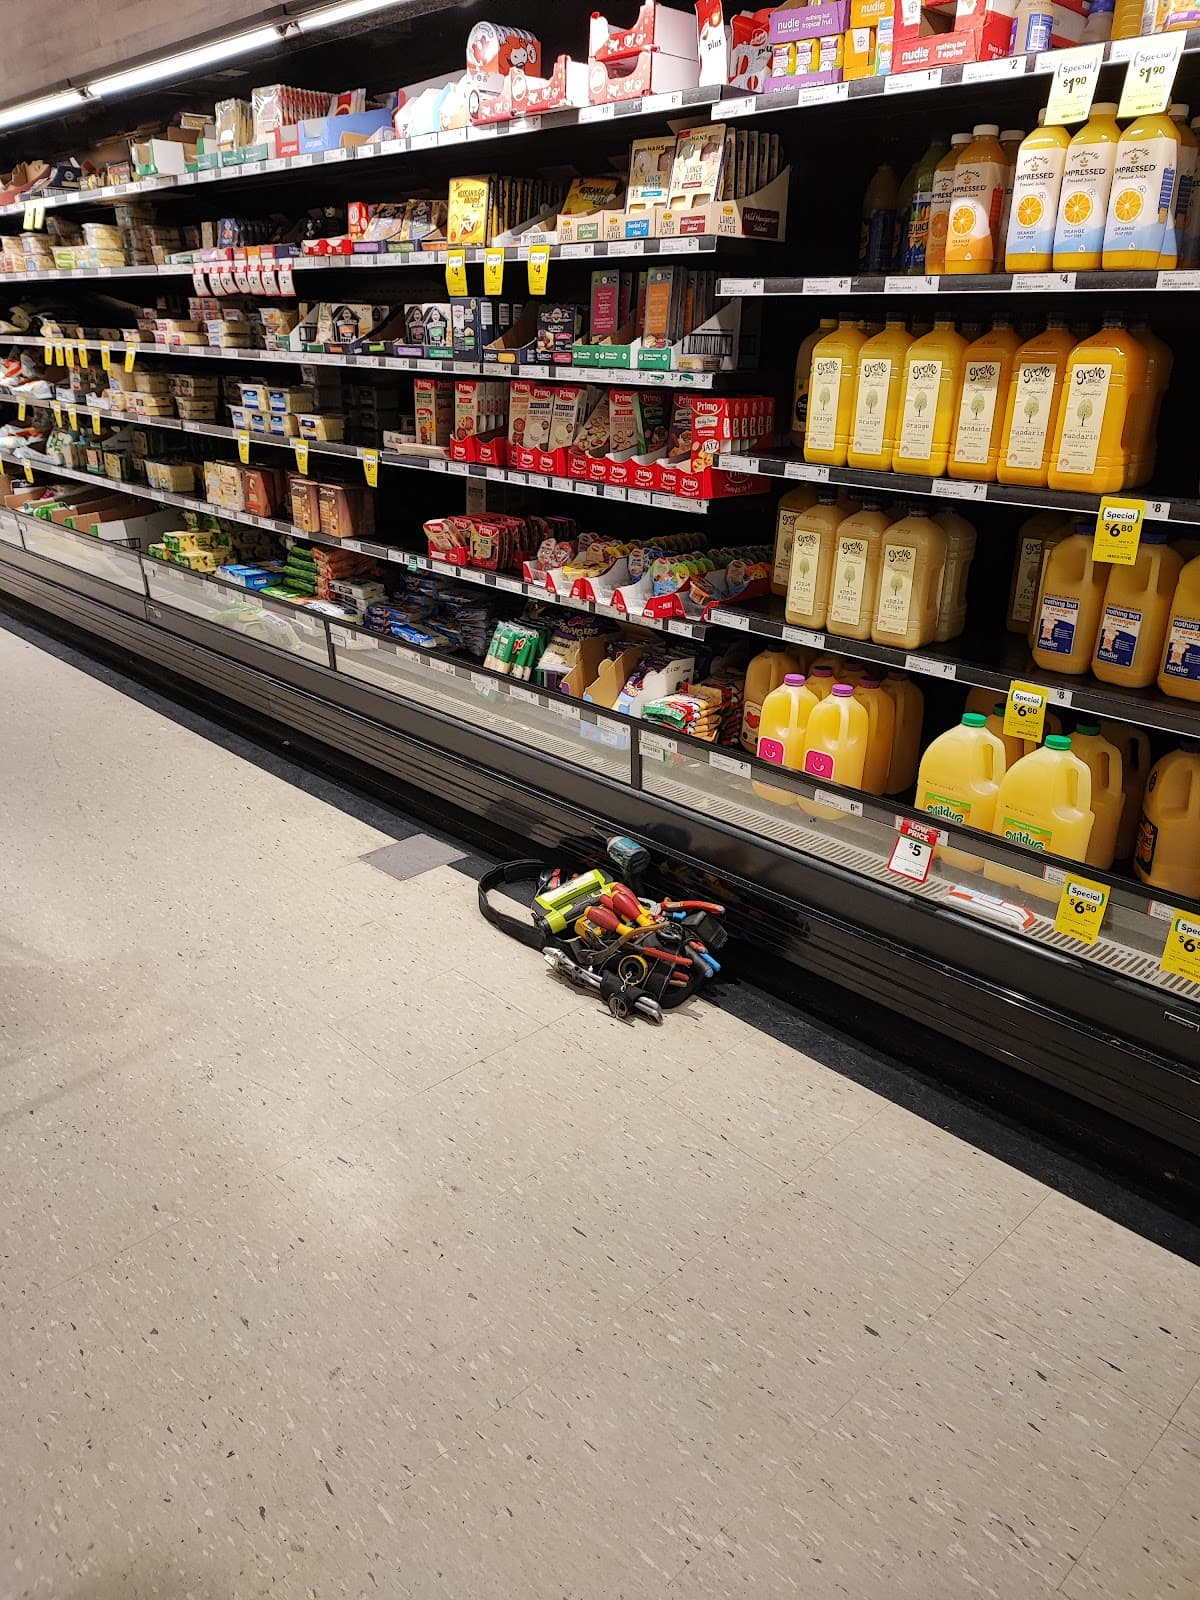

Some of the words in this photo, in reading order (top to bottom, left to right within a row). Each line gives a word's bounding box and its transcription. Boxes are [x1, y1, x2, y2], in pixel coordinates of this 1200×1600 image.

[861, 2, 886, 13] nudie
[777, 17, 800, 30] nudie
[902, 46, 929, 60] nudie
[1140, 51, 1171, 62] Special
[1063, 62, 1092, 74] Special
[1064, 168, 1106, 177] MPRESSED
[1115, 164, 1157, 174] MPRESSED
[1017, 172, 1055, 180] MPRESSED
[817, 360, 839, 376] grove
[864, 361, 888, 377] grove
[912, 363, 938, 379] grove
[969, 364, 996, 381] grove
[1023, 366, 1051, 384] grove
[1076, 367, 1106, 385] grove
[458, 383, 474, 392] Primo
[534, 389, 550, 398] Primo
[560, 388, 576, 398] Primo
[697, 402, 718, 412] Primo
[906, 423, 929, 431] orange
[637, 469, 652, 477] Primo
[682, 478, 698, 487] Primo
[1106, 511, 1136, 520] Special
[888, 549, 911, 562] grove
[1044, 599, 1066, 608] nothing
[1050, 607, 1074, 616] oranges
[1106, 608, 1128, 618] nothing
[1129, 613, 1141, 621] but
[1112, 616, 1137, 626] oranges
[1174, 620, 1200, 630] nothing
[1181, 629, 1200, 637] orang
[1039, 639, 1058, 647] nudie
[1099, 650, 1119, 659] nudie
[1166, 664, 1189, 674] nudie
[1015, 693, 1040, 704] Special
[911, 821, 929, 834] LOW
[907, 829, 929, 842] PRICE
[909, 842, 922, 857] $5
[1072, 887, 1100, 901] Special
[1181, 923, 1200, 936] Spec
